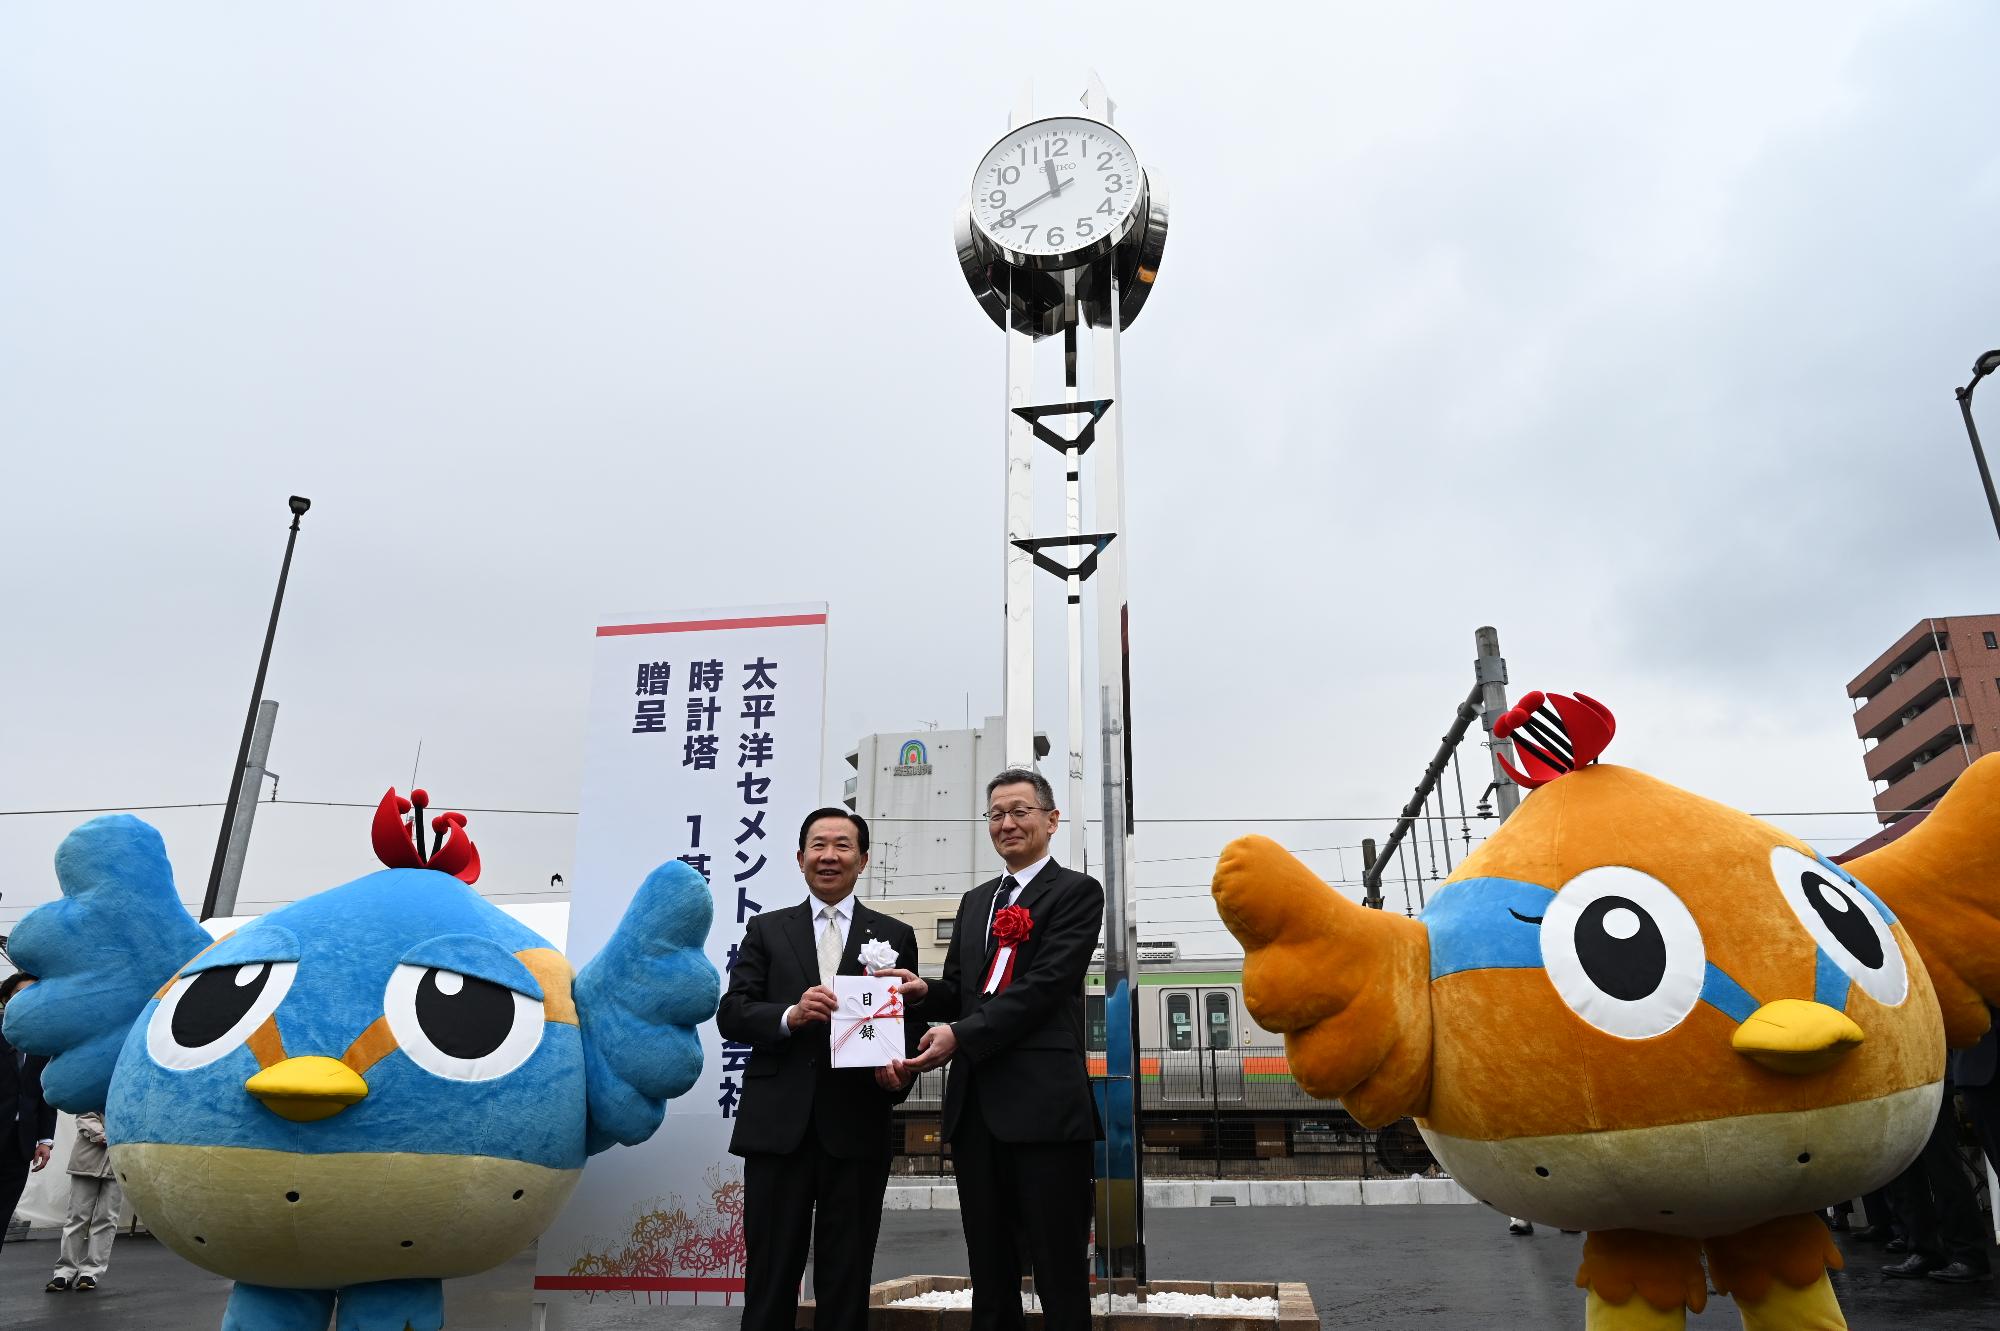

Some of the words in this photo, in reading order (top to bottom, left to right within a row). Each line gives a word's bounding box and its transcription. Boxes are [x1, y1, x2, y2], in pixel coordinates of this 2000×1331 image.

[1021, 146, 1038, 166] 11
[1044, 138, 1068, 157] 12
[1081, 139, 1087, 158] 1
[1039, 162, 1077, 174] SIKO
[1096, 151, 1114, 171] 2
[997, 165, 1021, 186] 10
[1104, 173, 1123, 194] 3
[988, 189, 1007, 210] 9
[1096, 197, 1116, 217] 4
[998, 209, 1017, 229] 8
[1075, 216, 1094, 237] 5
[1020, 224, 1039, 245] 7
[1046, 226, 1065, 247] 6
[631, 661, 671, 734] 贈呈
[682, 658, 724, 771] 時計塔
[734, 656, 778, 924] 太平洋セメント
